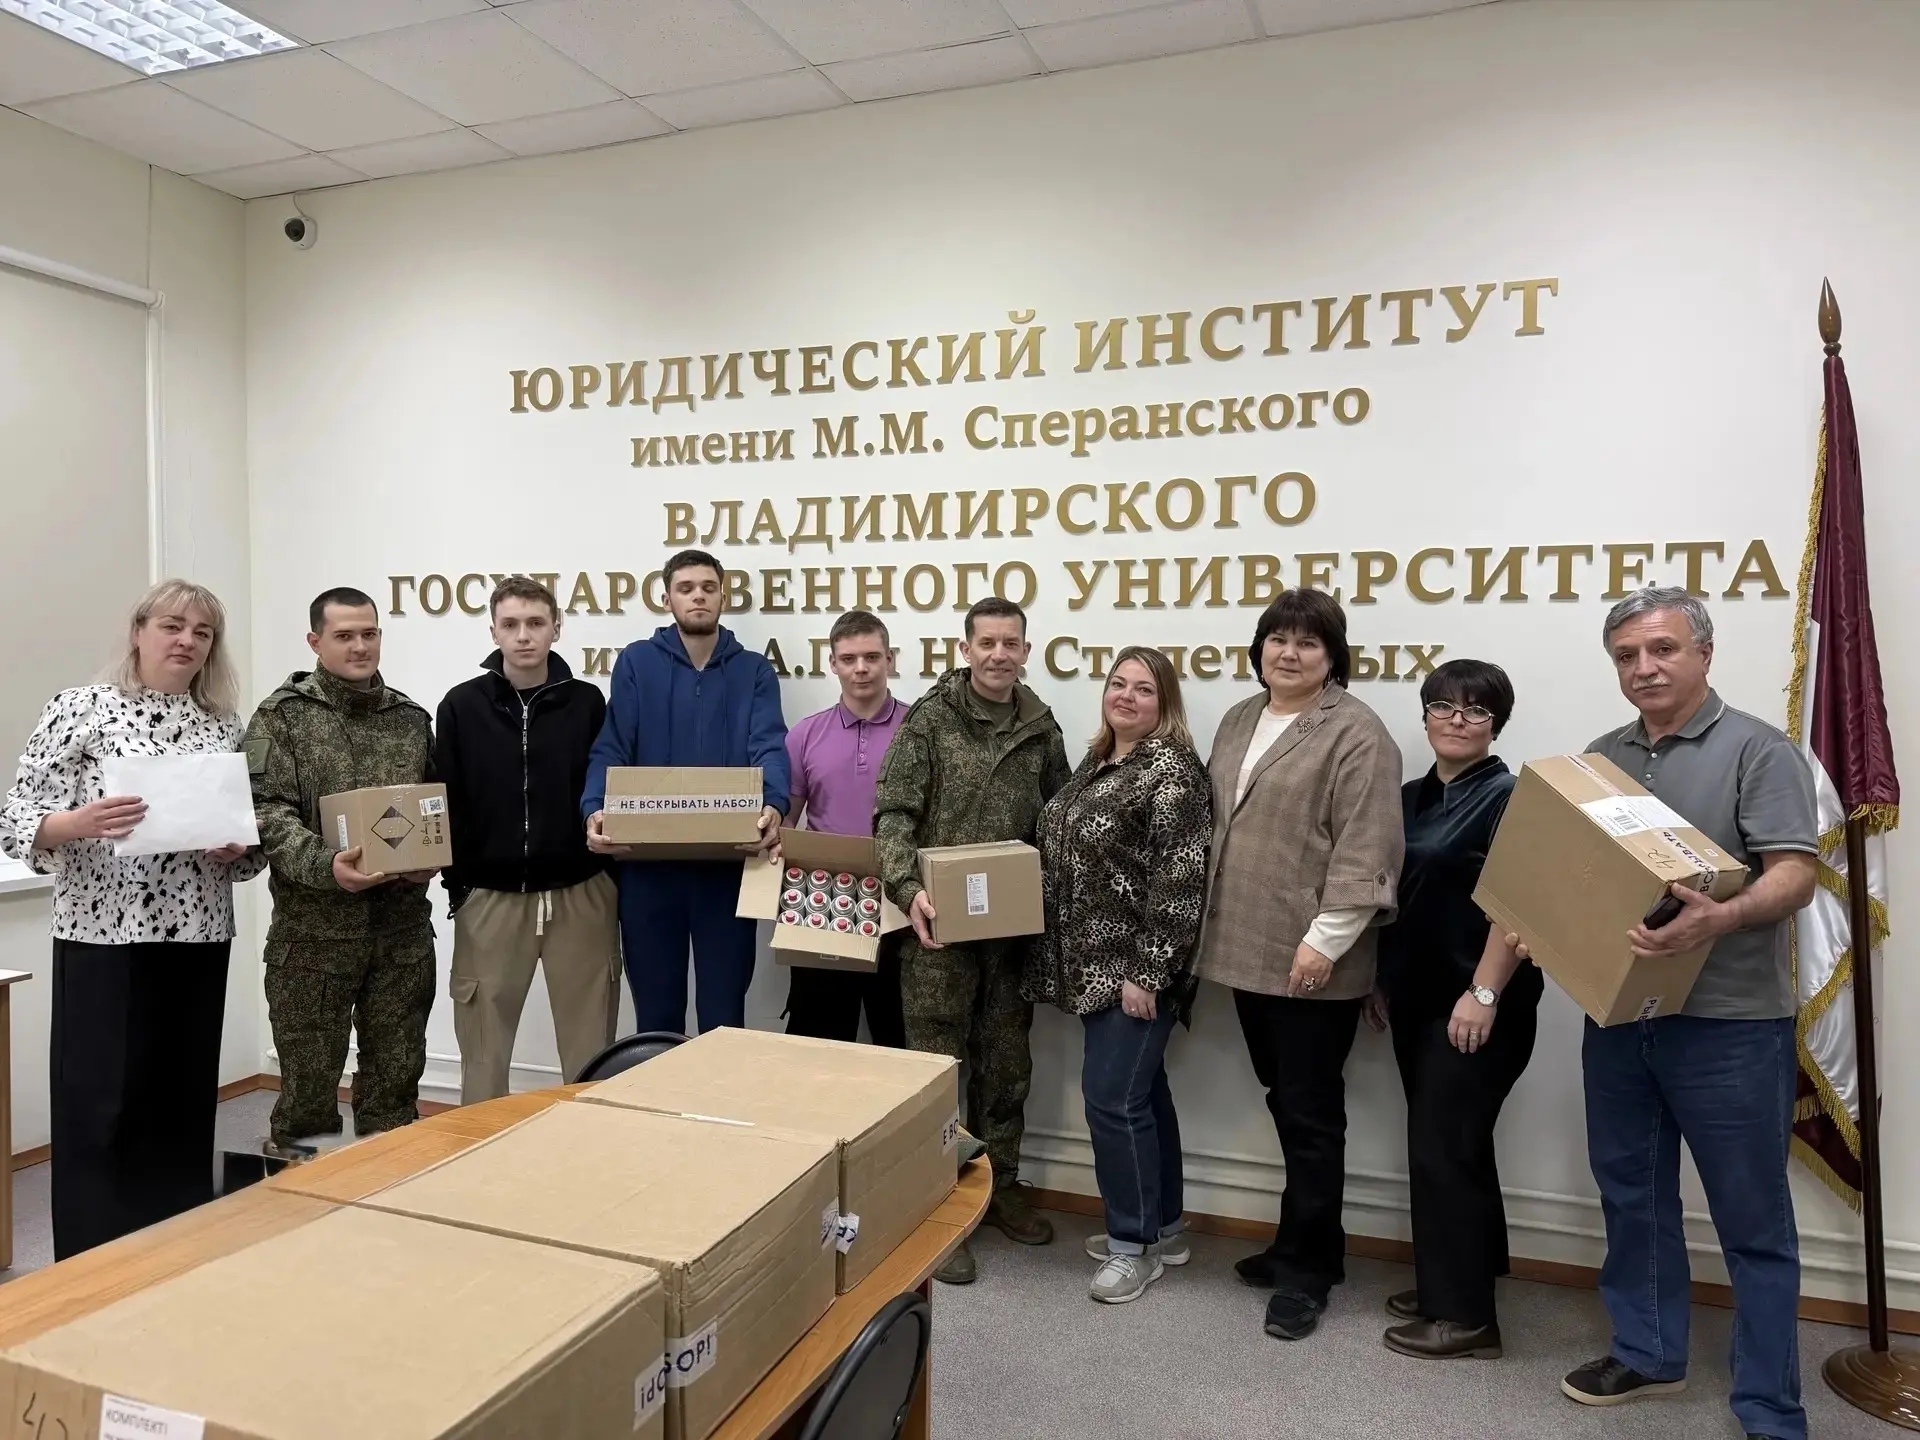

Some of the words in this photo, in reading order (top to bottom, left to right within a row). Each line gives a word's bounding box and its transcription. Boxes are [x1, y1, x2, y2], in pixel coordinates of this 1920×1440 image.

[509, 308, 1046, 413] ЮРИДИЧЕСКИЙ
[1073, 276, 1559, 373] ИНСТИТУТ
[630, 428, 795, 468] имени
[812, 410, 944, 459] М.М.
[964, 386, 1371, 458] Сперанского
[662, 471, 1317, 553] ВЛАДИМИРСКОГО
[1064, 539, 1791, 612] УНИВЕРСИТЕТА
[620, 801, 635, 809] НЕ
[640, 799, 709, 809] ВСКРЫВАТЬ
[714, 799, 758, 808] НАБОР!
